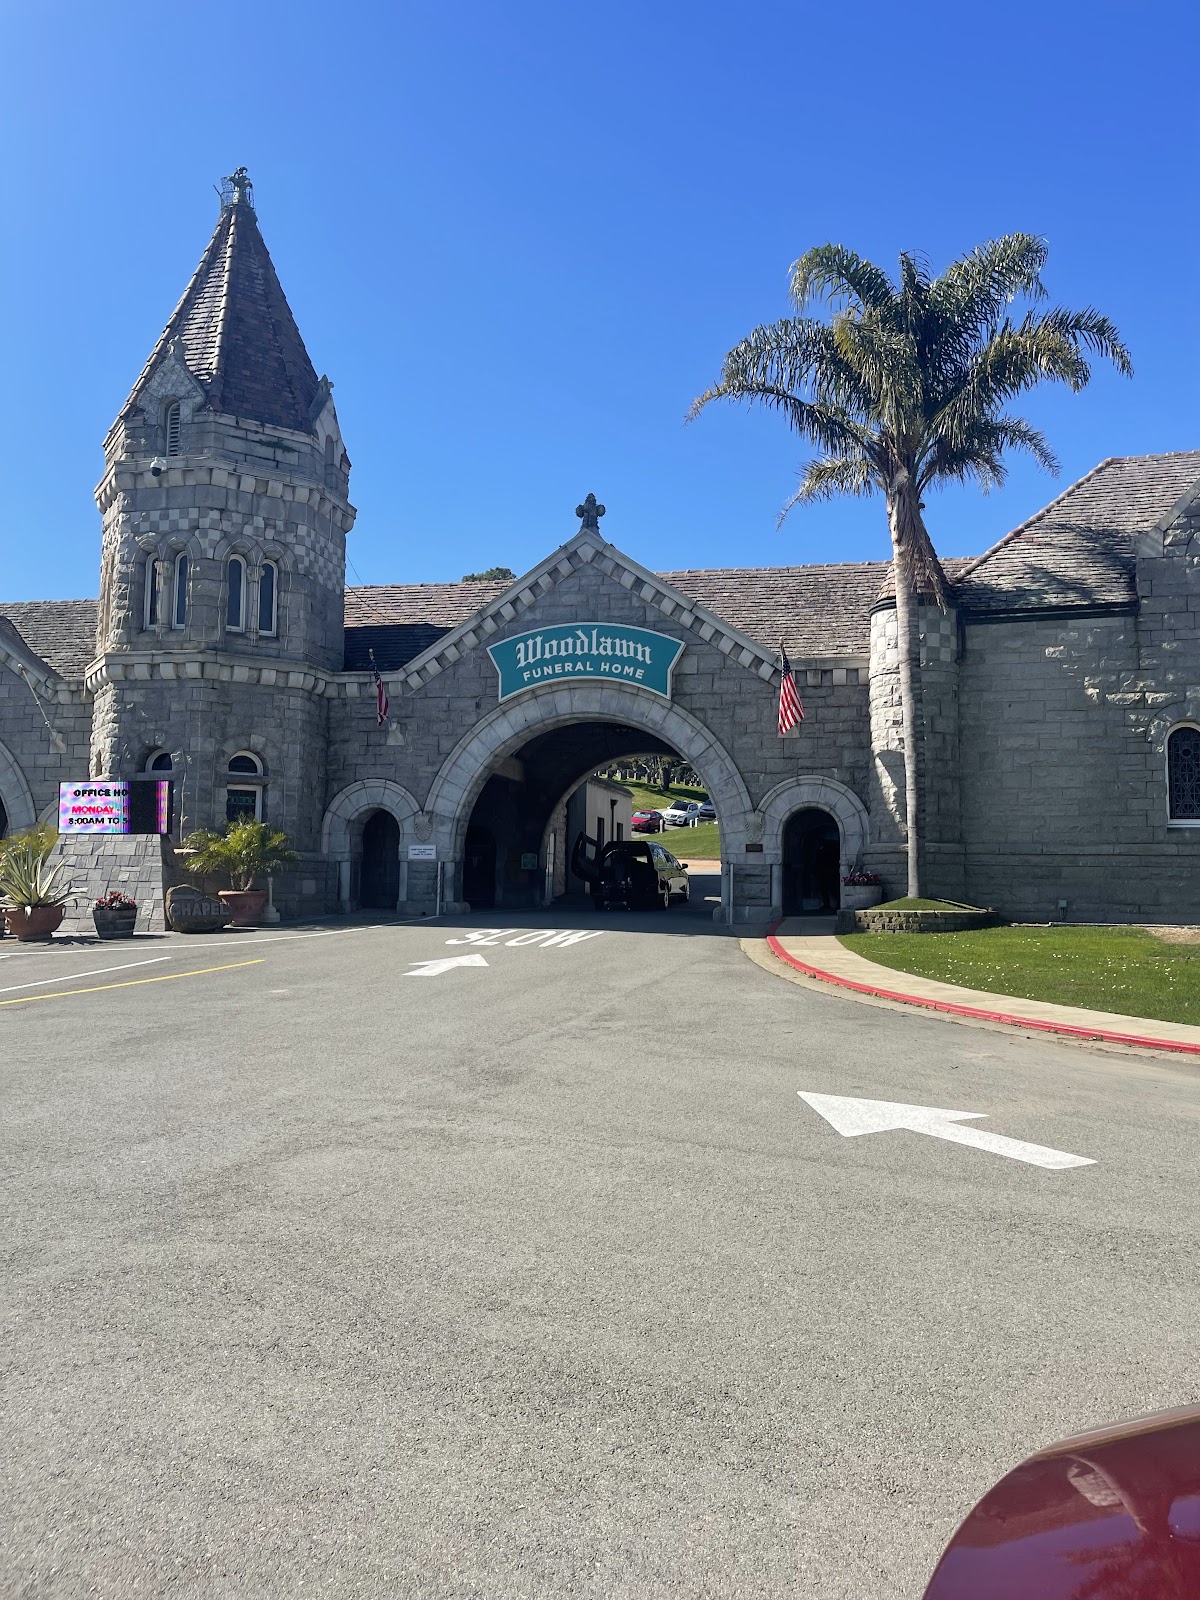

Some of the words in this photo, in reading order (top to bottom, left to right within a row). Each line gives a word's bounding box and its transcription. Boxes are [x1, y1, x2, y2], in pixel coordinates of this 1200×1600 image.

[516, 628, 652, 669] Woodlawn
[522, 661, 594, 681] FUNERAL
[600, 662, 645, 679] HOME
[73, 789, 111, 797] OFFICE
[72, 806, 114, 815] MONDAY
[171, 902, 230, 916] CHAPEL
[444, 929, 605, 948] SLOW
